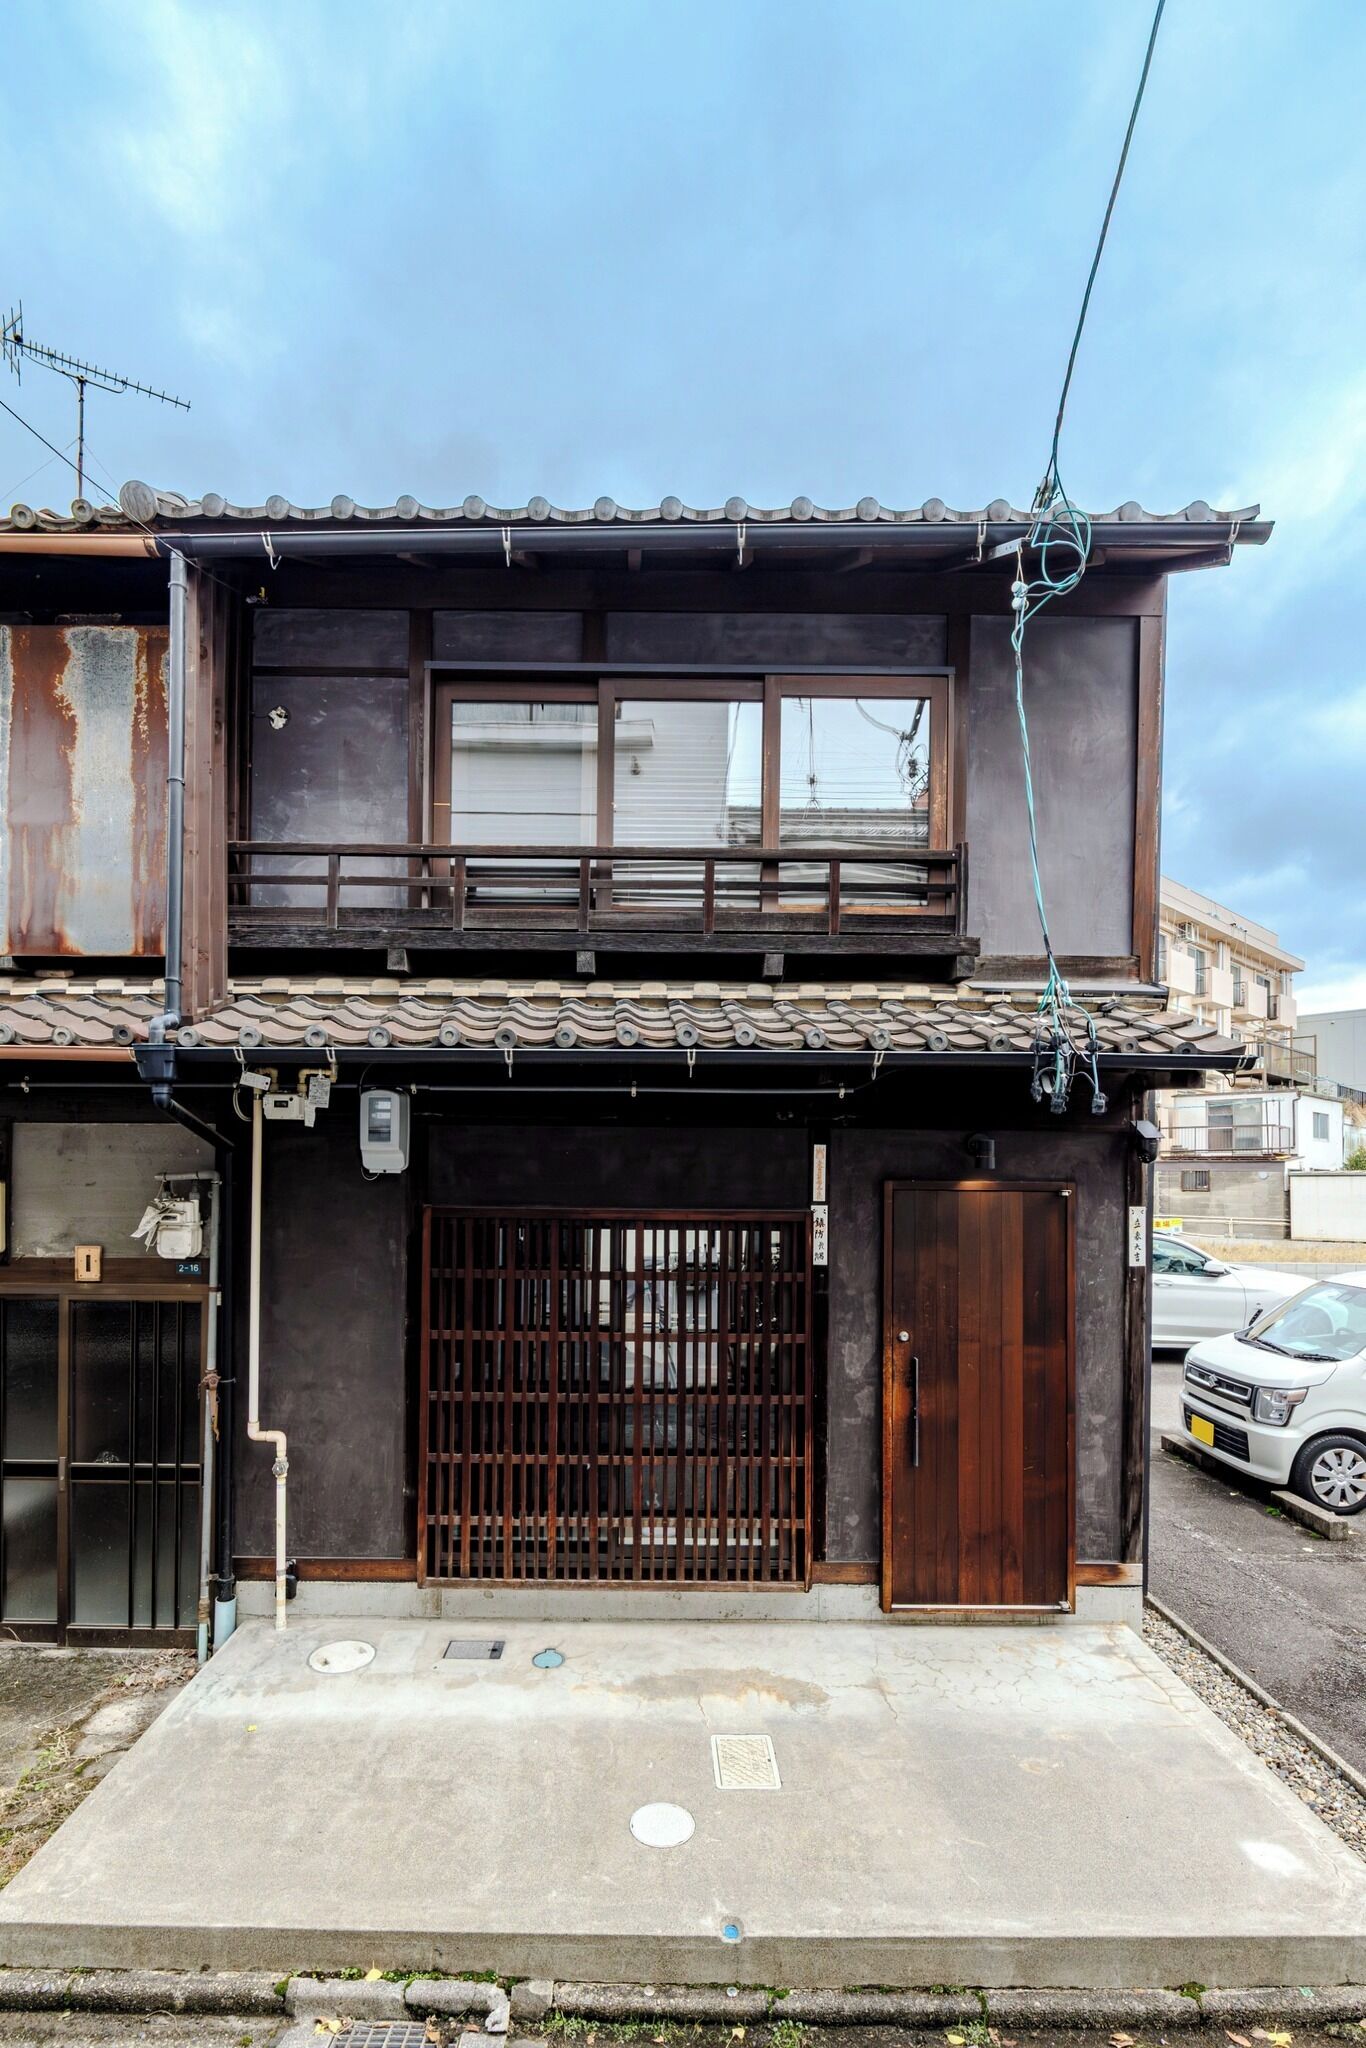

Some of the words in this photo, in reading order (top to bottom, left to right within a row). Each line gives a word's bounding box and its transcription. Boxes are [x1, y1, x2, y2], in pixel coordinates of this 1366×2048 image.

[1134, 1218, 1142, 1262] 立春大吉
[178, 1264, 199, 1273] 2-16
